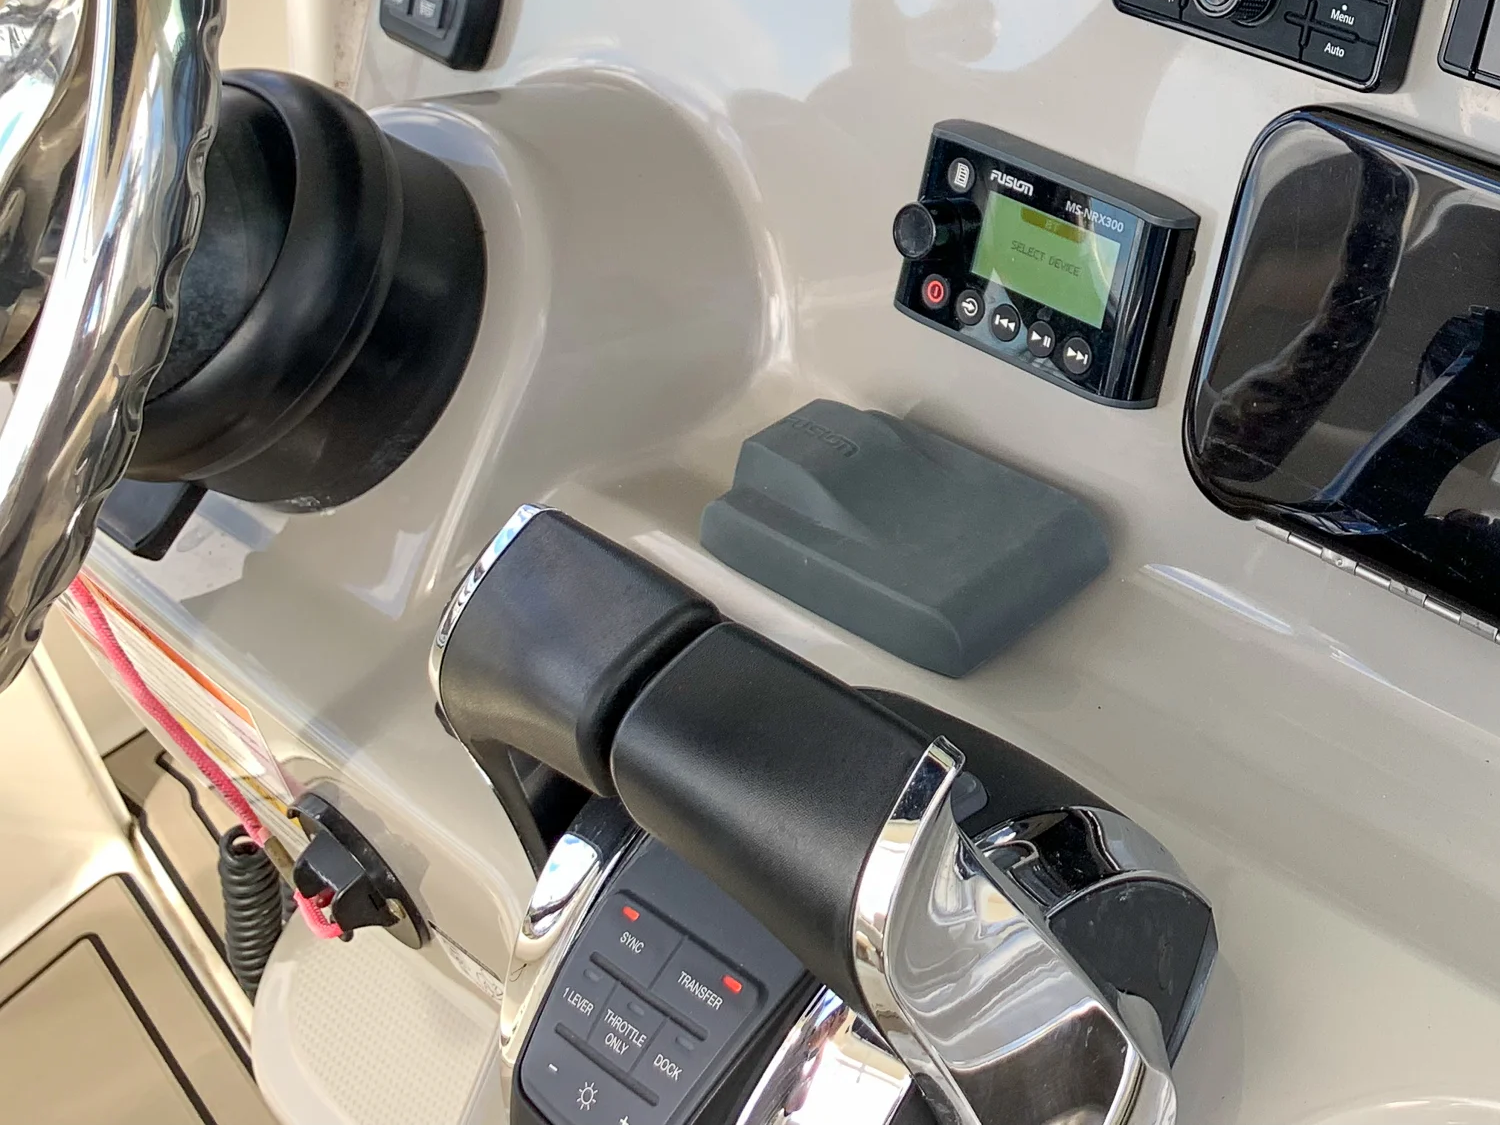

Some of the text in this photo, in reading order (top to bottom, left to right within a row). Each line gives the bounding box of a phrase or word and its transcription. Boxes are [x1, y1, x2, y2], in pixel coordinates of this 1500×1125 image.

[1330, 8, 1355, 26] Menu
[1323, 42, 1345, 58] Auto
[1064, 199, 1125, 233] MS-NRX300
[1010, 239, 1081, 277] SELECT DEVICE
[619, 931, 645, 954] SYNC
[562, 987, 594, 1016] 1 LEVER
[677, 970, 724, 1011] TRANSFER
[603, 1008, 648, 1048] THROTTLE
[604, 1032, 630, 1056] ONLY
[653, 1053, 684, 1082] DOCK
